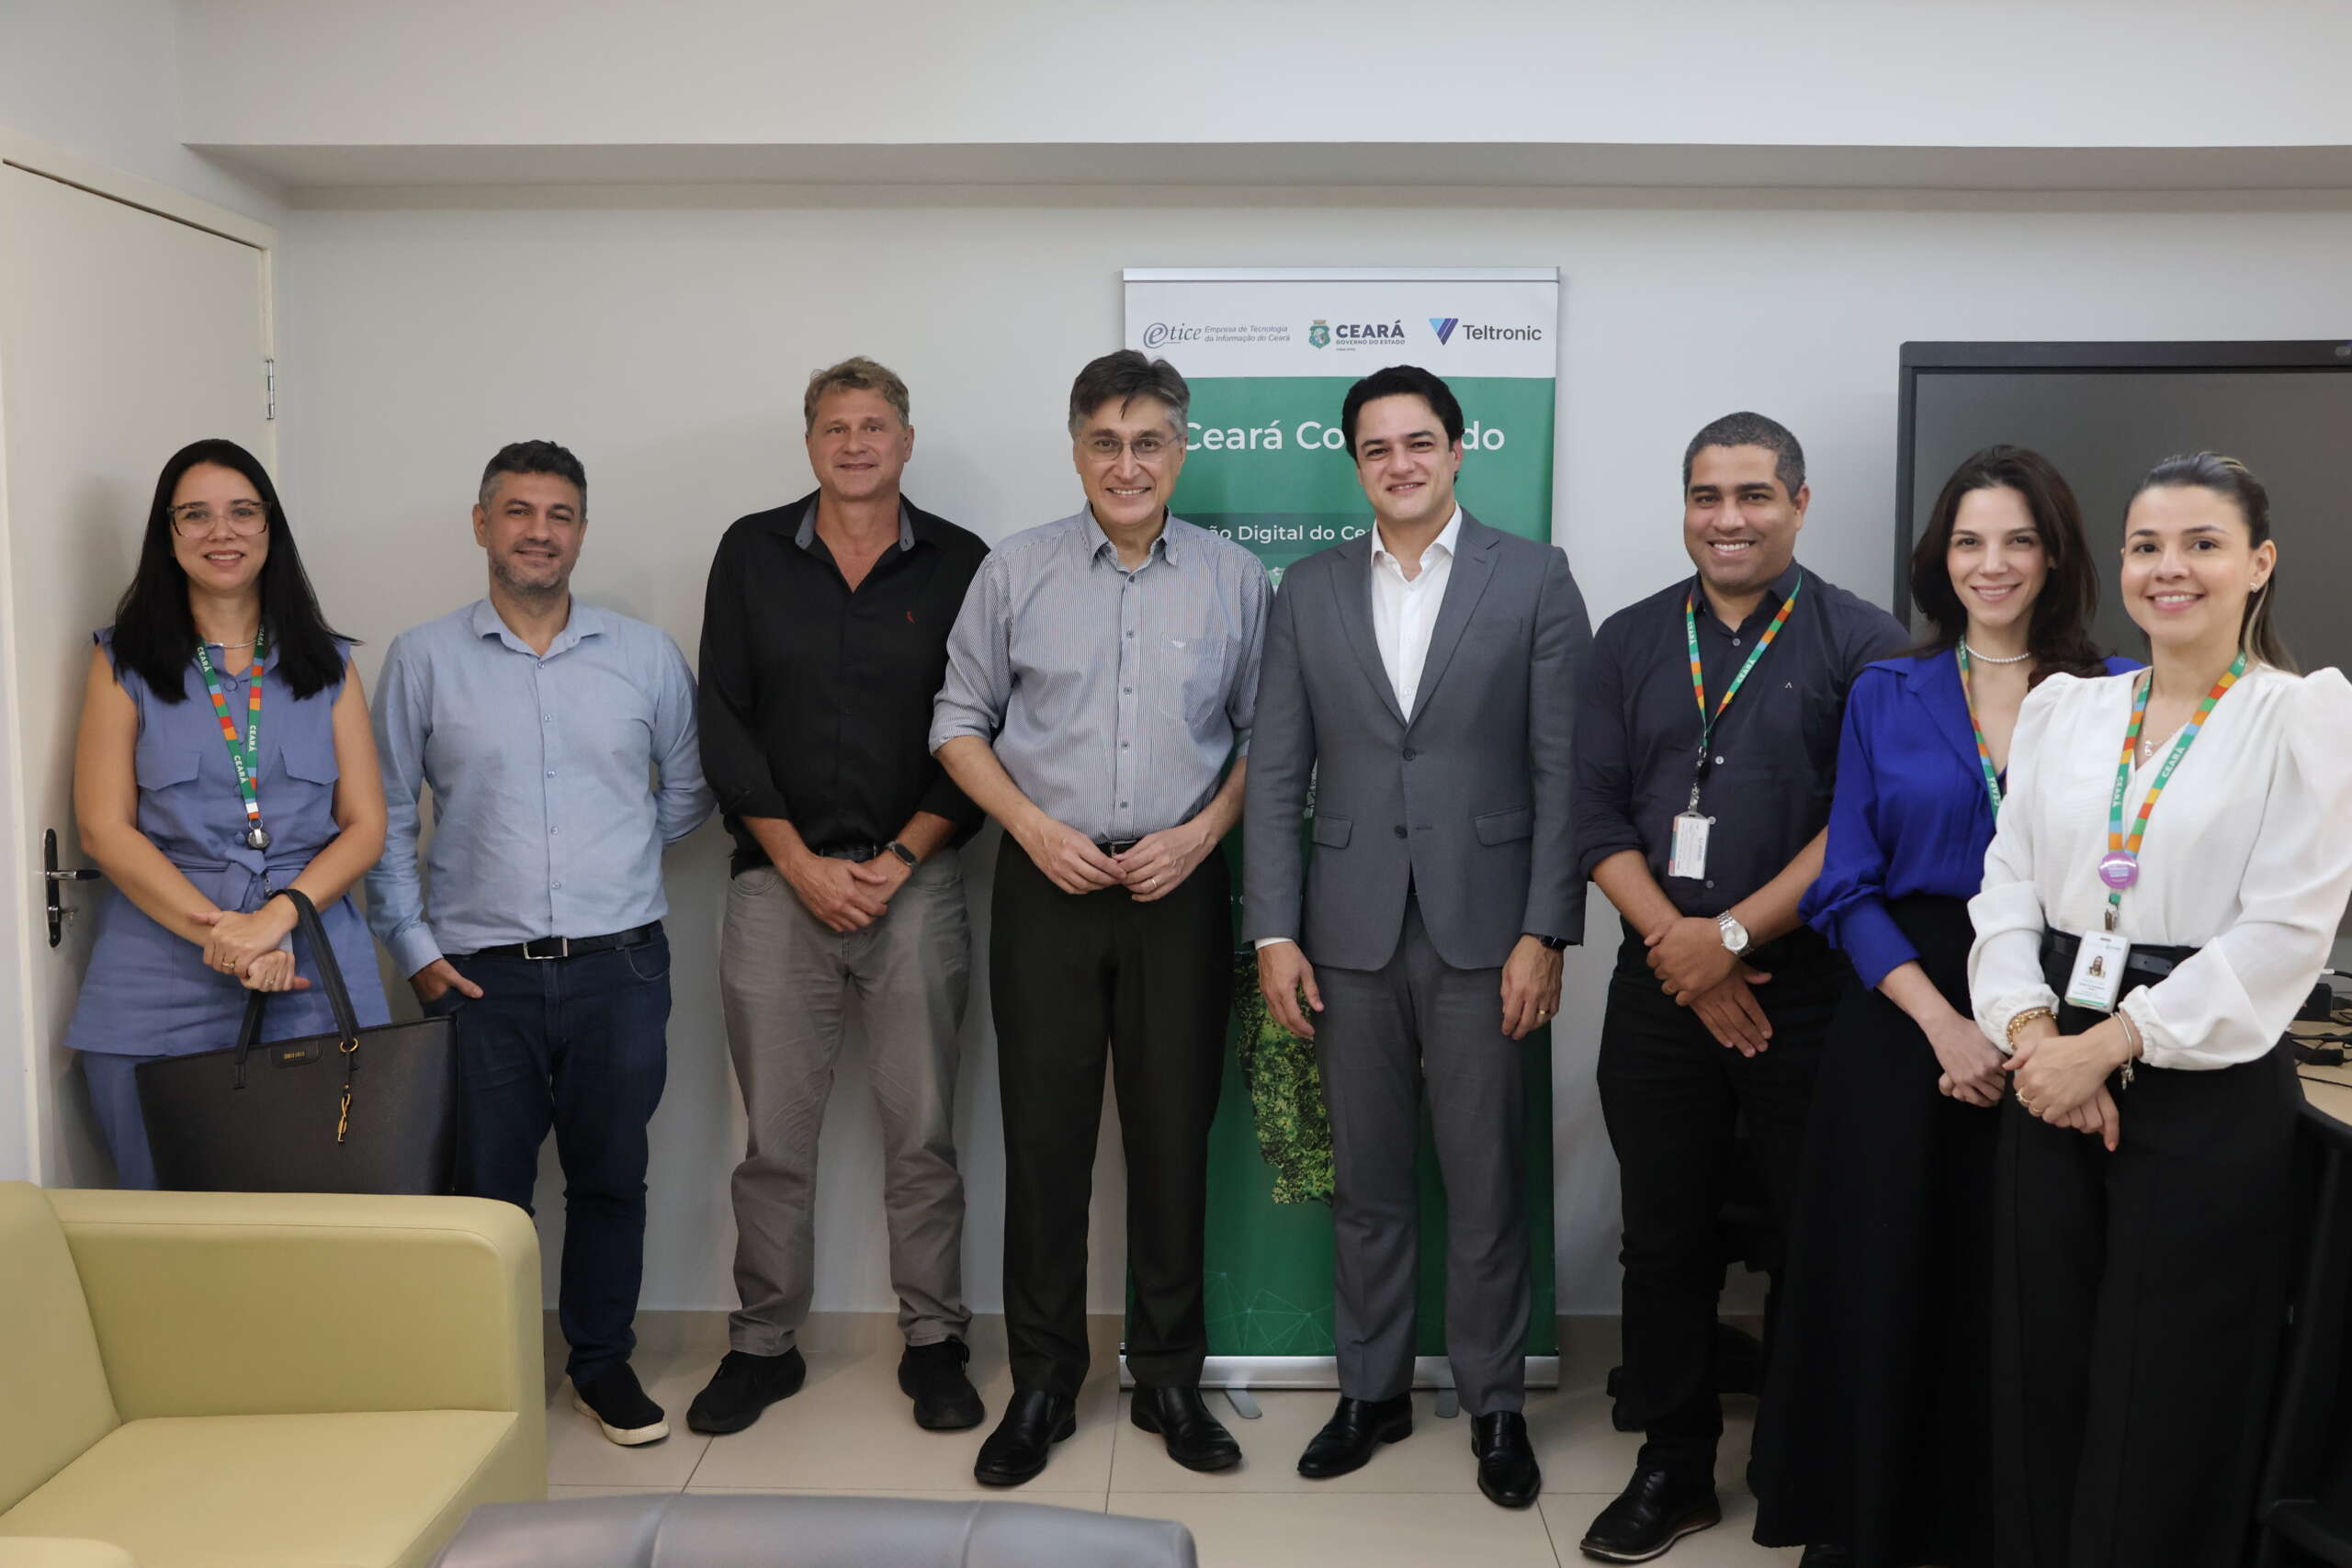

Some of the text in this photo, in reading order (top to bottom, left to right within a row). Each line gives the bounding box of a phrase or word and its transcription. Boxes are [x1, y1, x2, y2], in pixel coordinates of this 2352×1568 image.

[1204, 325, 1237, 334] Empresa
[1250, 325, 1288, 334] Tecnologia
[1216, 334, 1256, 344] Informação
[1258, 333, 1267, 342] do
[1269, 333, 1290, 342] Ceará
[1336, 320, 1406, 339] CEARÁ
[1463, 325, 1543, 341] Teltronic
[1186, 420, 1283, 451] Ceará
[1238, 525, 1303, 545] Digital
[1310, 525, 1335, 541] do
[1687, 621, 1697, 645] CEARÁ
[197, 646, 209, 672] CEARÁ
[1736, 659, 1757, 683] CEARÁ
[249, 724, 257, 752] CEARÁ
[234, 754, 249, 784] CEARÁ
[2162, 747, 2186, 779] CEARÁ
[2112, 775, 2124, 808] CEARÁ
